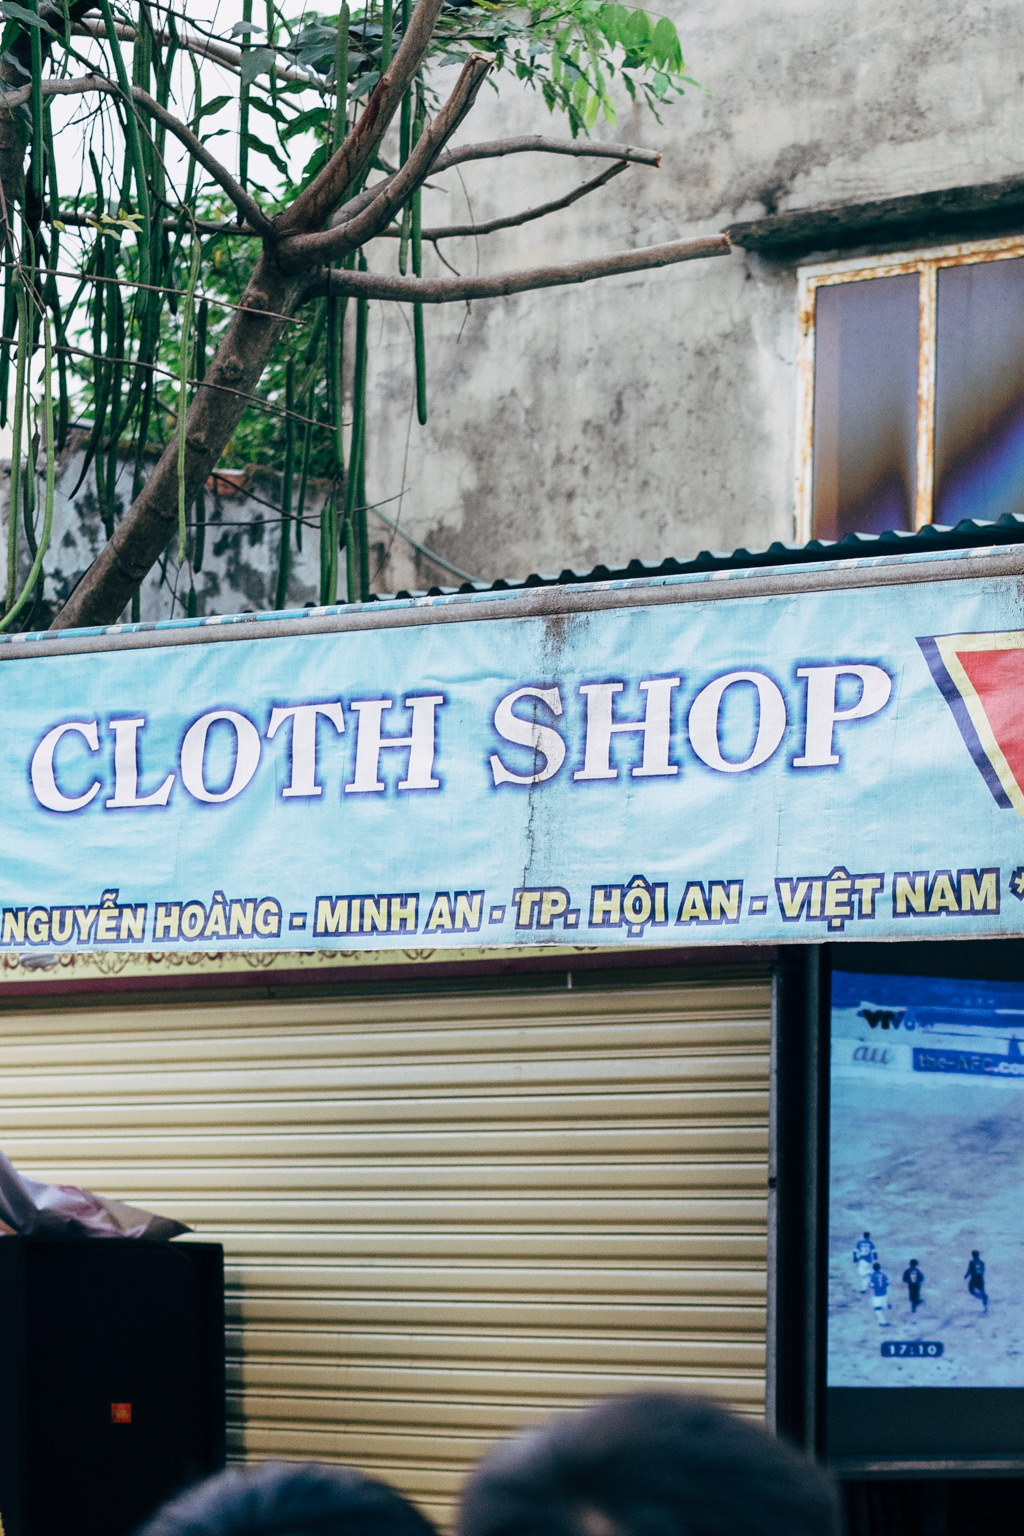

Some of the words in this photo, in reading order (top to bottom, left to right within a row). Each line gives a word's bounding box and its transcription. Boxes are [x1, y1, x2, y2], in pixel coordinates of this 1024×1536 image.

[29, 692, 447, 815] CLOTH
[488, 661, 894, 788] SHOP
[1, 890, 147, 945] NGUYỄN
[152, 890, 282, 942] HOÀNG
[313, 894, 419, 937] MINH
[422, 890, 485, 934] AN
[513, 886, 580, 929] TP.
[588, 874, 668, 937] HỘI
[674, 880, 743, 926] AN
[774, 866, 884, 931] VIỆT
[892, 868, 1000, 918] NAM
[890, 1344, 938, 1356] 17:10
